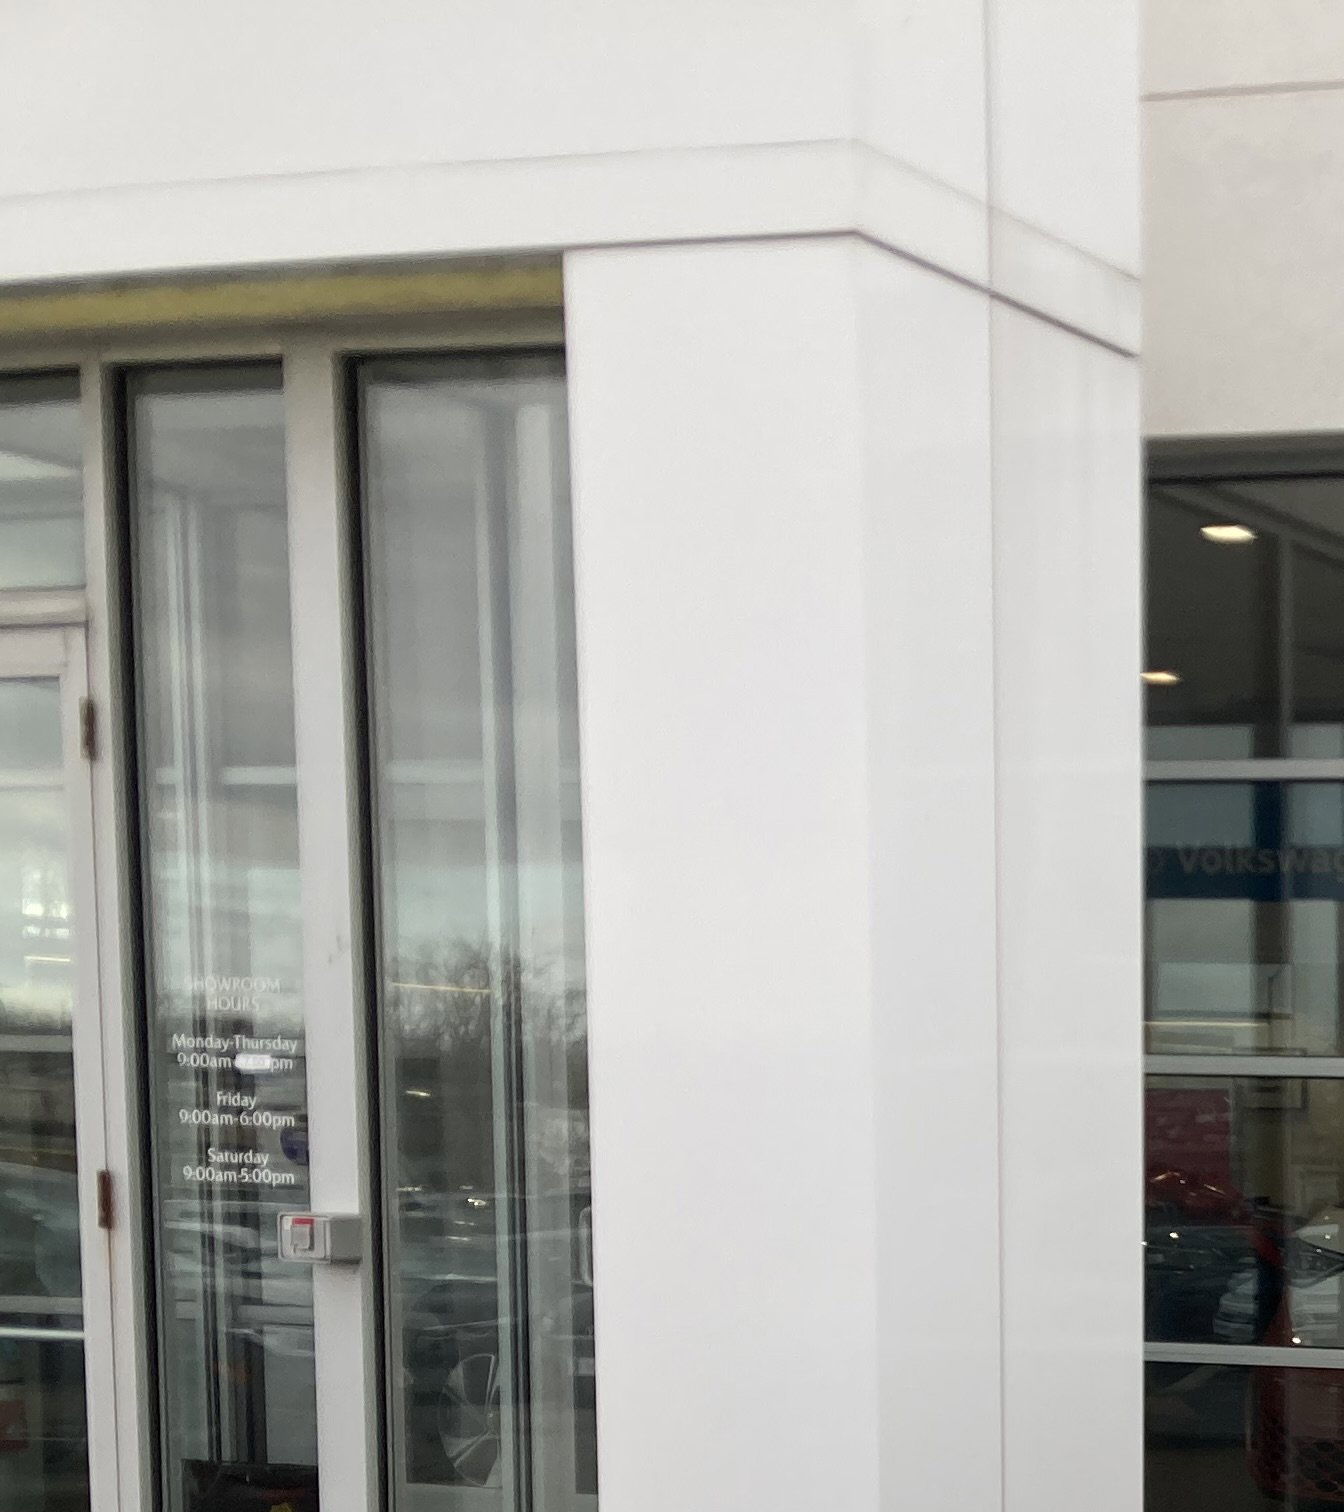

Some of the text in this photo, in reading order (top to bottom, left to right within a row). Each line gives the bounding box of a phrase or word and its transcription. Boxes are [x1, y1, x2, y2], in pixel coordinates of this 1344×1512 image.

[171, 1032, 298, 1054] Monday-Thursday
[216, 1090, 257, 1110] Friday
[179, 1109, 295, 1130] 9:00am-6:00pm
[207, 1147, 270, 1167] Saturday
[183, 1165, 295, 1187] 9:00am-5:00pm
